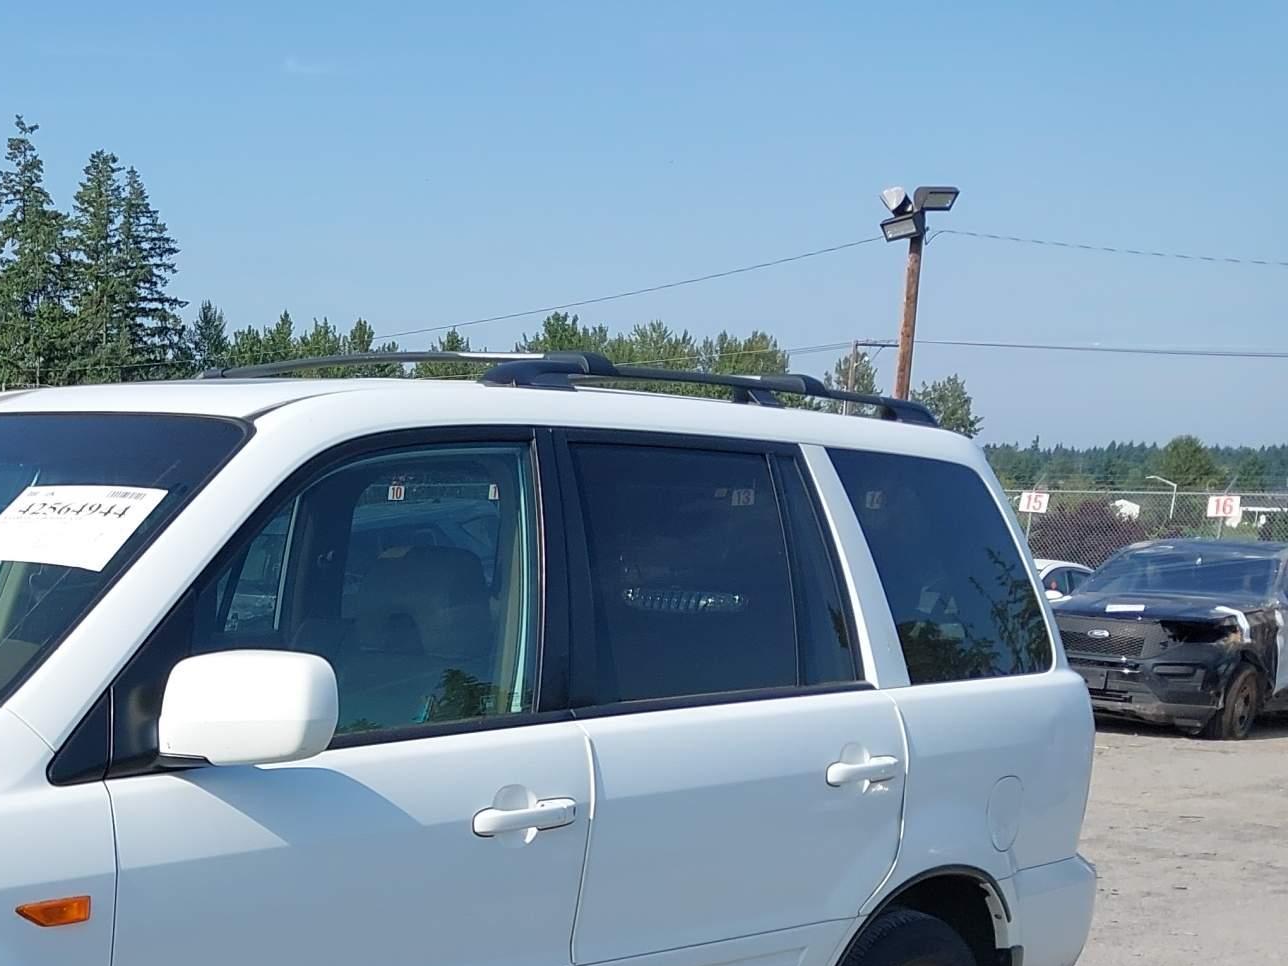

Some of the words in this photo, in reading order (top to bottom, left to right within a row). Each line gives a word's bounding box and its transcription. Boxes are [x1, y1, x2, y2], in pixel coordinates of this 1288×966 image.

[392, 486, 402, 499] 10
[736, 490, 751, 504] 13
[18, 502, 131, 518] 42564944
[1026, 494, 1043, 511] 15
[1215, 498, 1234, 515] 16
